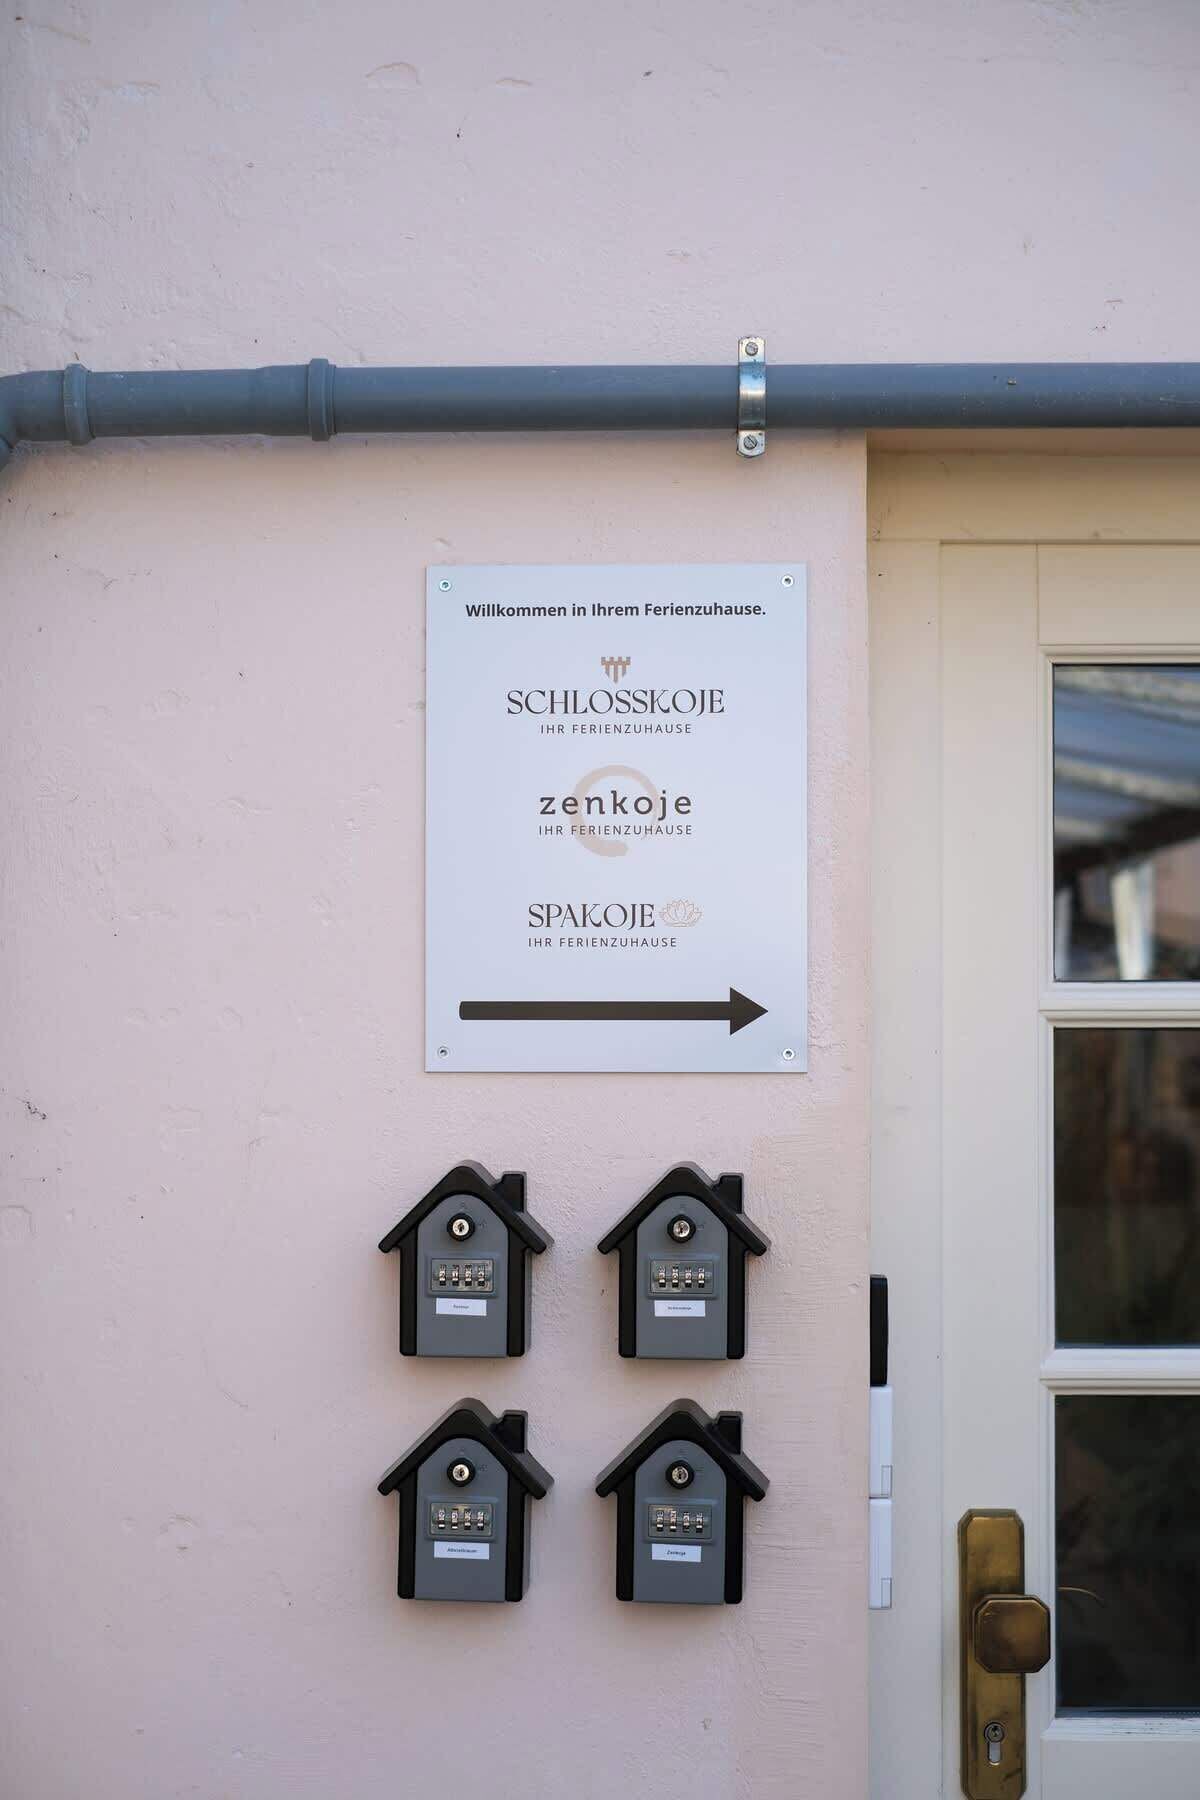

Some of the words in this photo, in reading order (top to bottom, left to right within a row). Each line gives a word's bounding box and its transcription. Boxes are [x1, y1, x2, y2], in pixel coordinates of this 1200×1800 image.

[465, 602, 567, 617] Willkommen
[571, 603, 587, 616] in
[591, 603, 640, 616] Ihrem
[644, 602, 767, 616] Ferienzuhause.
[506, 689, 725, 716] SCHLOSSKOJE
[540, 724, 565, 734] IHR
[572, 723, 692, 734] FERIENZUHAUSE
[539, 790, 692, 821] zenkoje
[538, 825, 563, 836] IHR
[571, 824, 692, 835] FERIENZUHAUSE
[528, 903, 655, 930] SPAKOJE
[528, 938, 552, 947] IHR
[559, 937, 677, 947] FERIENZUHAUSE
